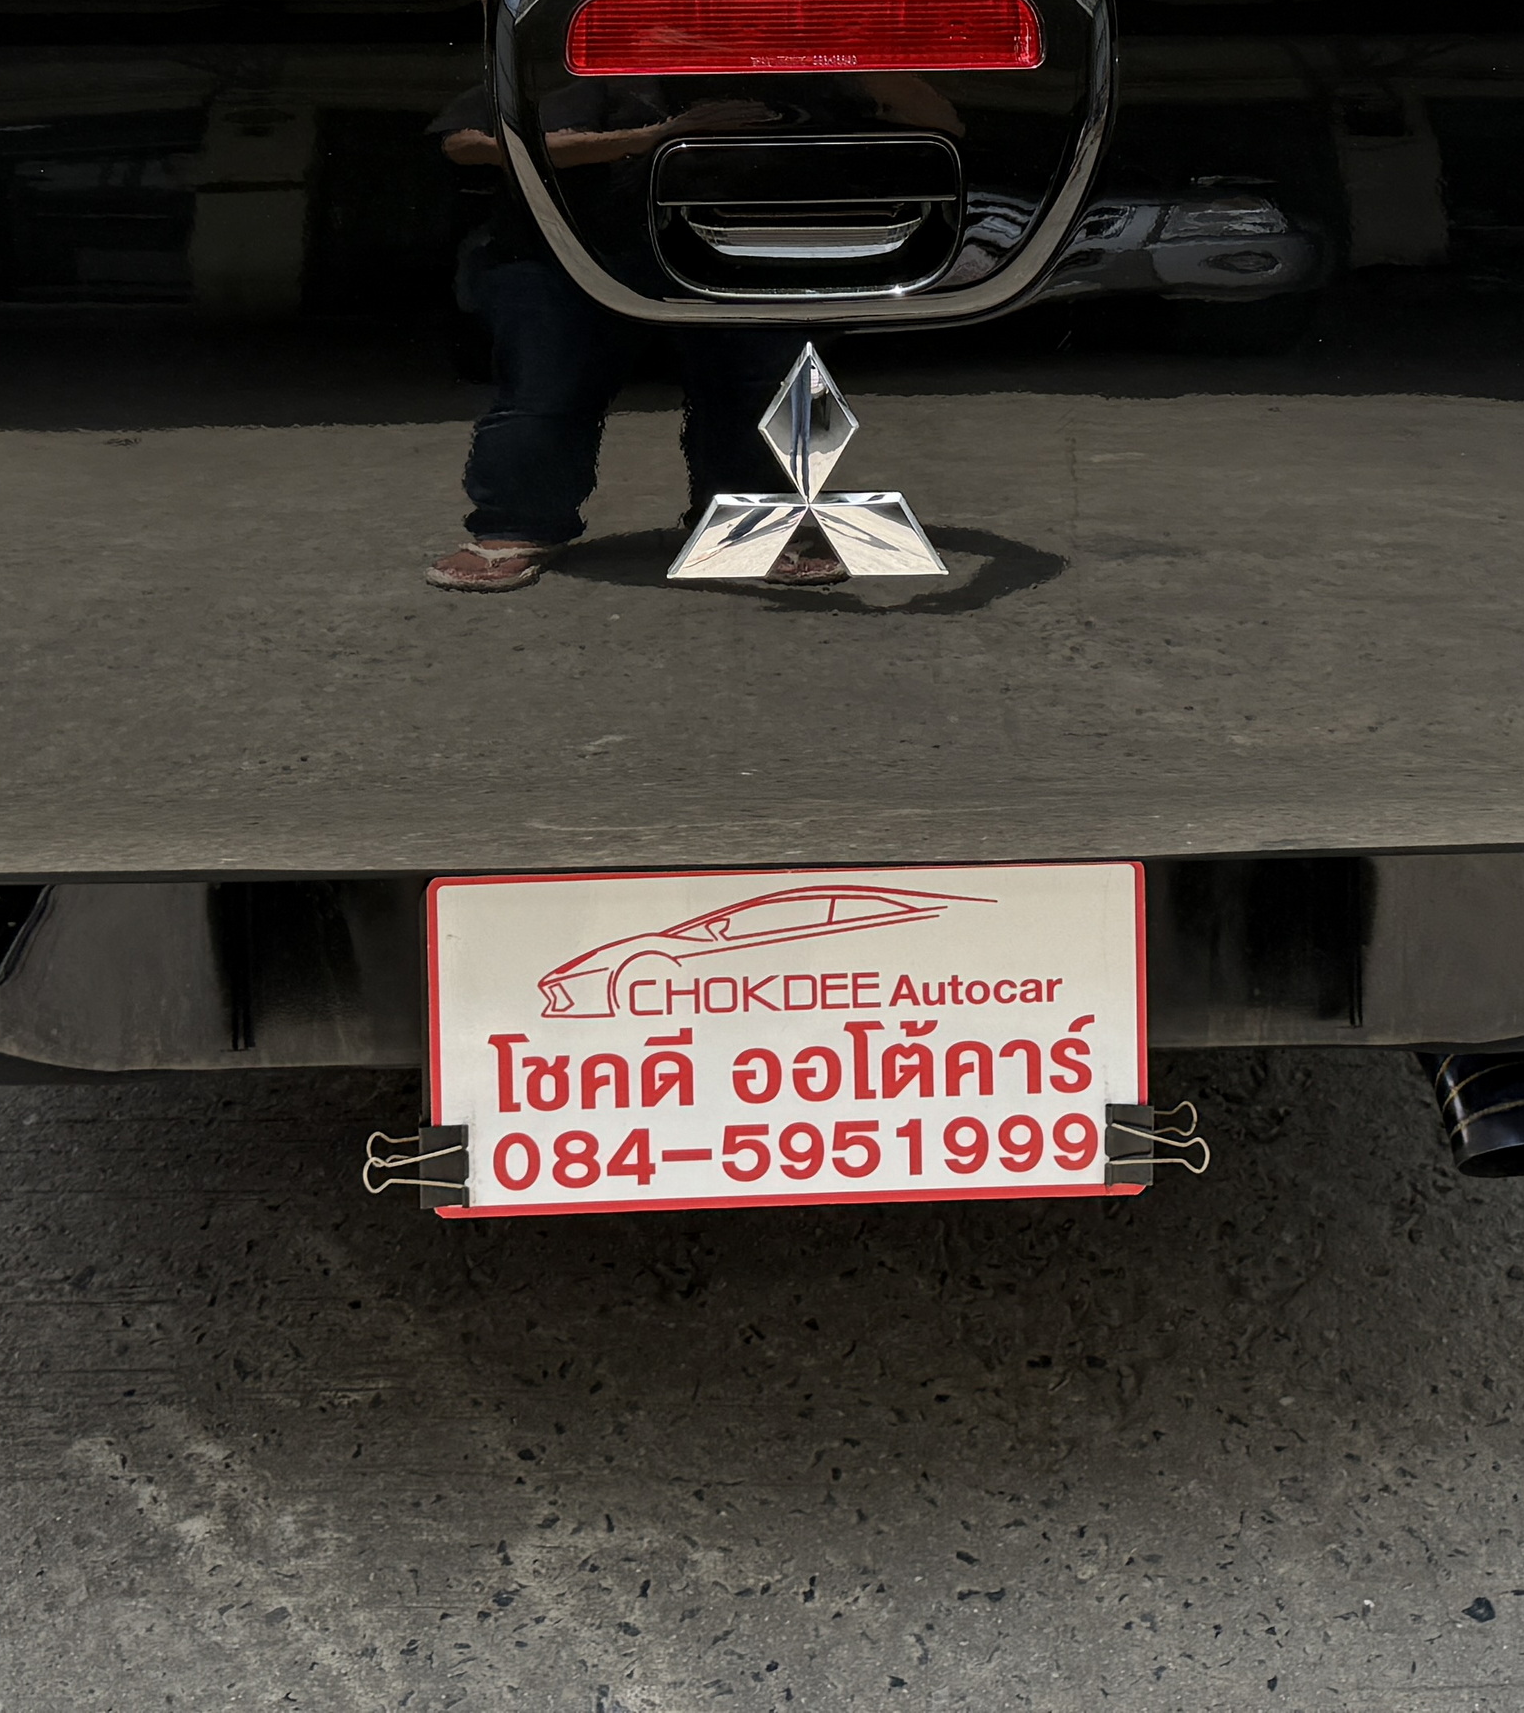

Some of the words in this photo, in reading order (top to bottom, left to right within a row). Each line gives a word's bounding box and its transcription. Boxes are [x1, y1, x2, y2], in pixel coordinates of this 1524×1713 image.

[628, 972, 882, 1017] CHOKDEE
[889, 974, 1064, 1007] Autocar
[488, 1027, 697, 1114] โชคดี
[731, 1014, 1096, 1105] ออโต้คาร์
[492, 1112, 1101, 1192] 084-5951999
